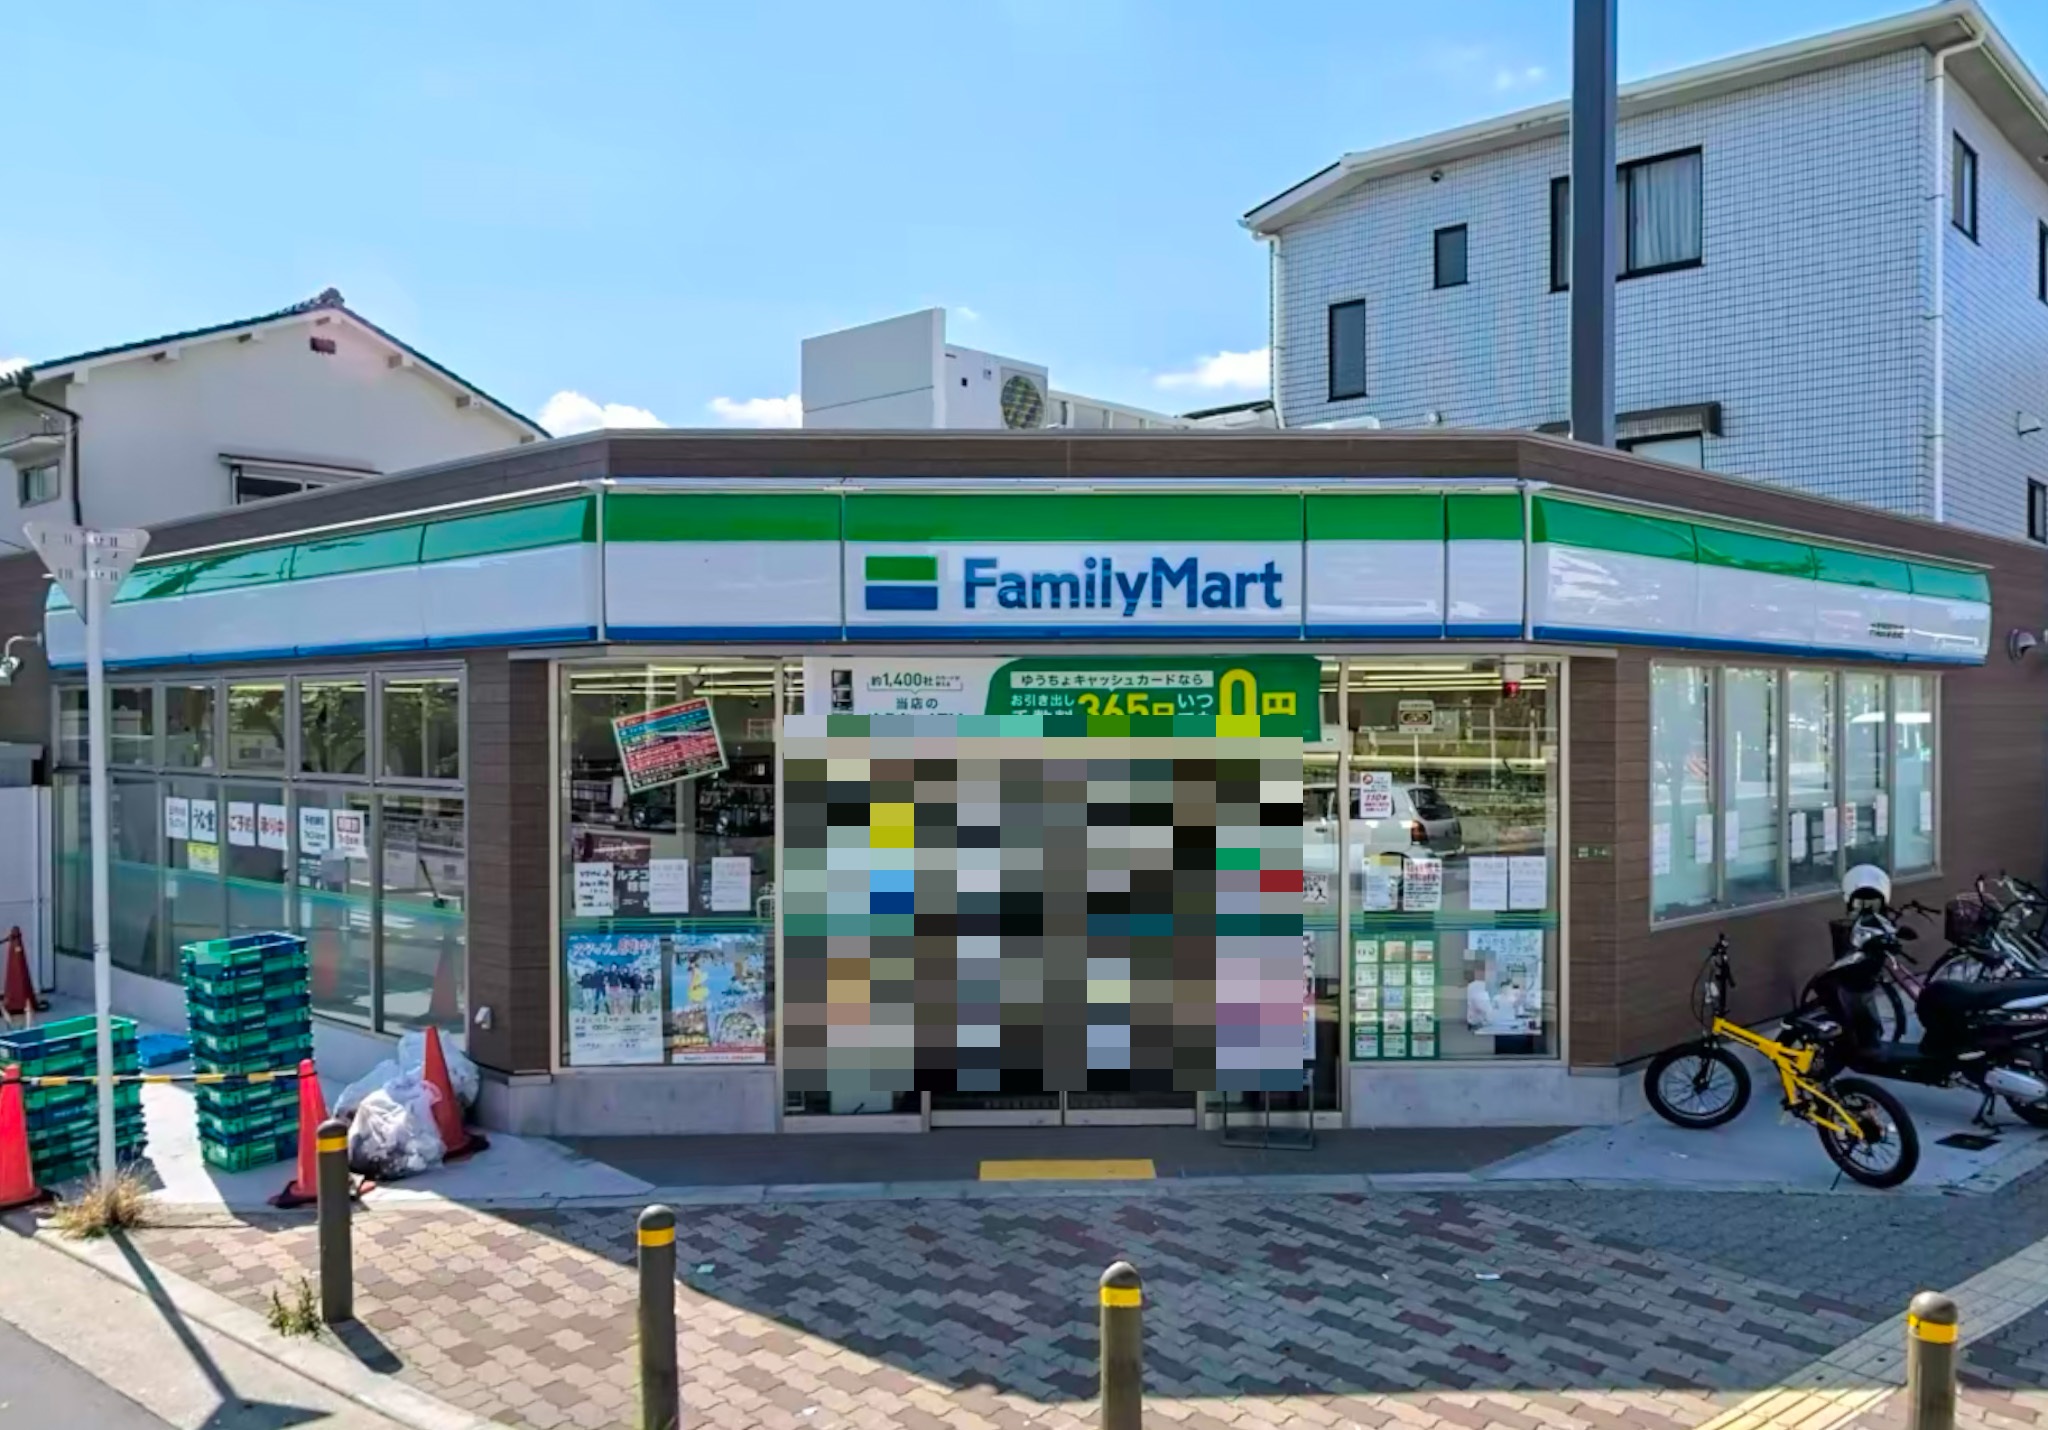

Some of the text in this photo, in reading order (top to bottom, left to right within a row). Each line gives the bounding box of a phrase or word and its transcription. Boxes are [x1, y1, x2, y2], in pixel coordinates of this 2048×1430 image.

[963, 556, 1283, 616] FamilyMart
[1021, 674, 1203, 687] ゆうちょキャッシュカードなら
[896, 697, 938, 710] 当店の
[1010, 693, 1075, 707] お引き出し
